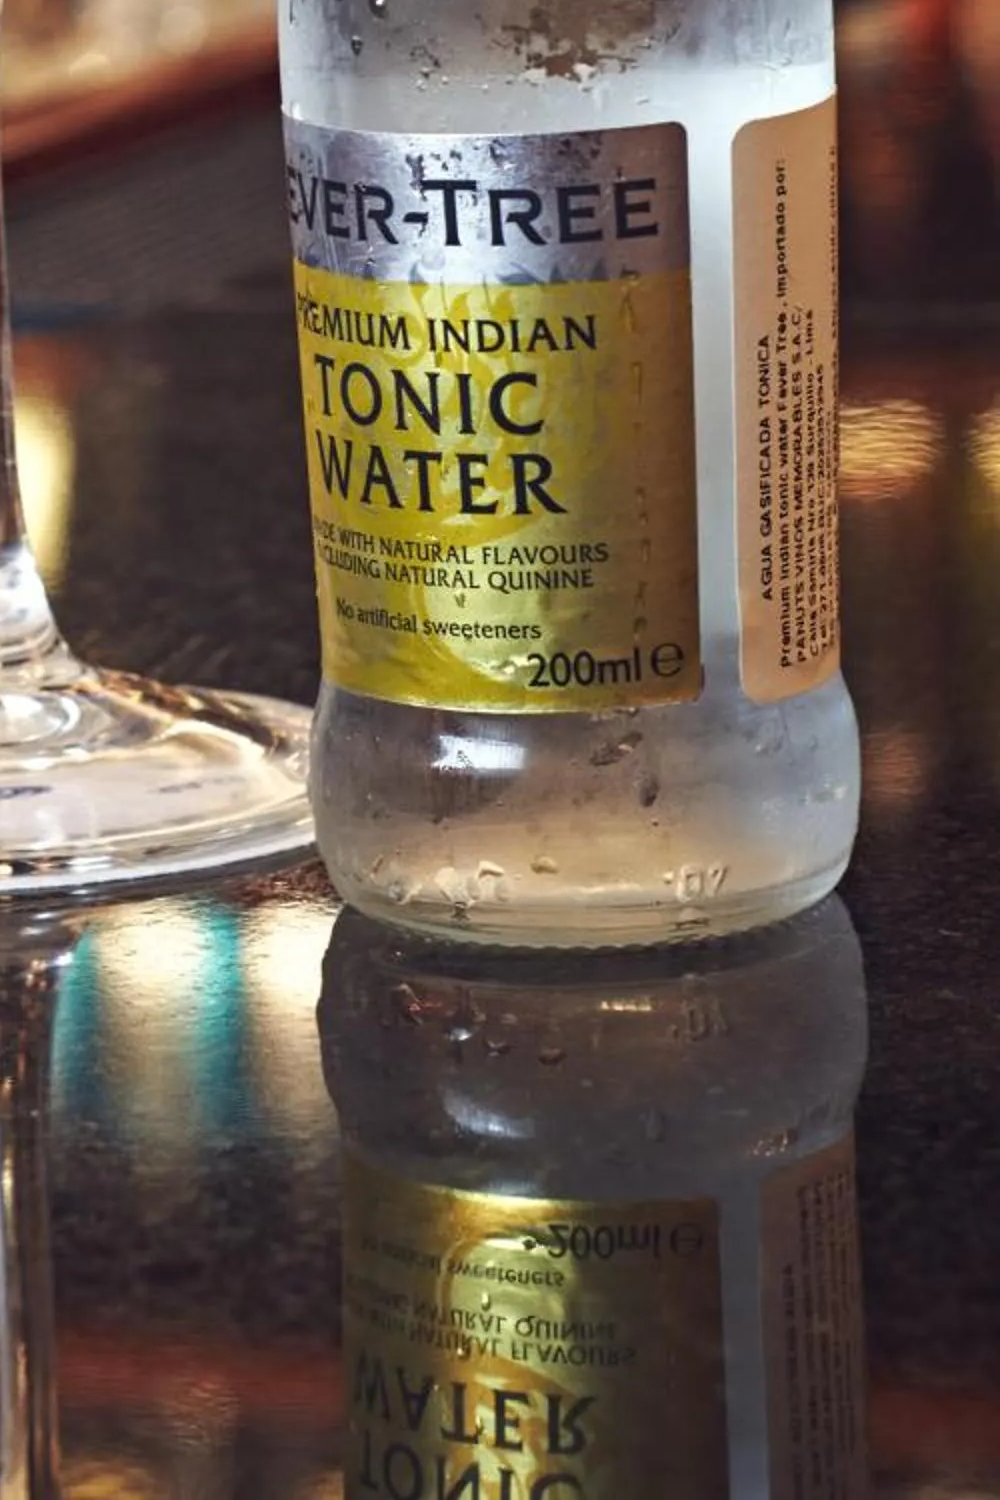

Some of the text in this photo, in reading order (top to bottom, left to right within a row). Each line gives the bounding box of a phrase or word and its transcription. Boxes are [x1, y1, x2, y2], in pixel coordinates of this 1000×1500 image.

[426, 314, 598, 355] INDIAN
[313, 353, 545, 436] TONIC
[777, 417, 788, 468] water
[315, 429, 568, 515] WATER
[757, 335, 773, 601] AGUA GASIFICADA TONICA
[779, 473, 789, 519] tonic
[337, 526, 375, 554] WITH
[379, 536, 475, 565] NATURAL
[482, 542, 610, 565] FLAVOURS
[385, 561, 481, 589] NATURAL
[487, 568, 595, 594] QUININE
[336, 596, 542, 640] No artificial sweeteners
[780, 585, 792, 668] Premium
[527, 646, 642, 687] 200ml
